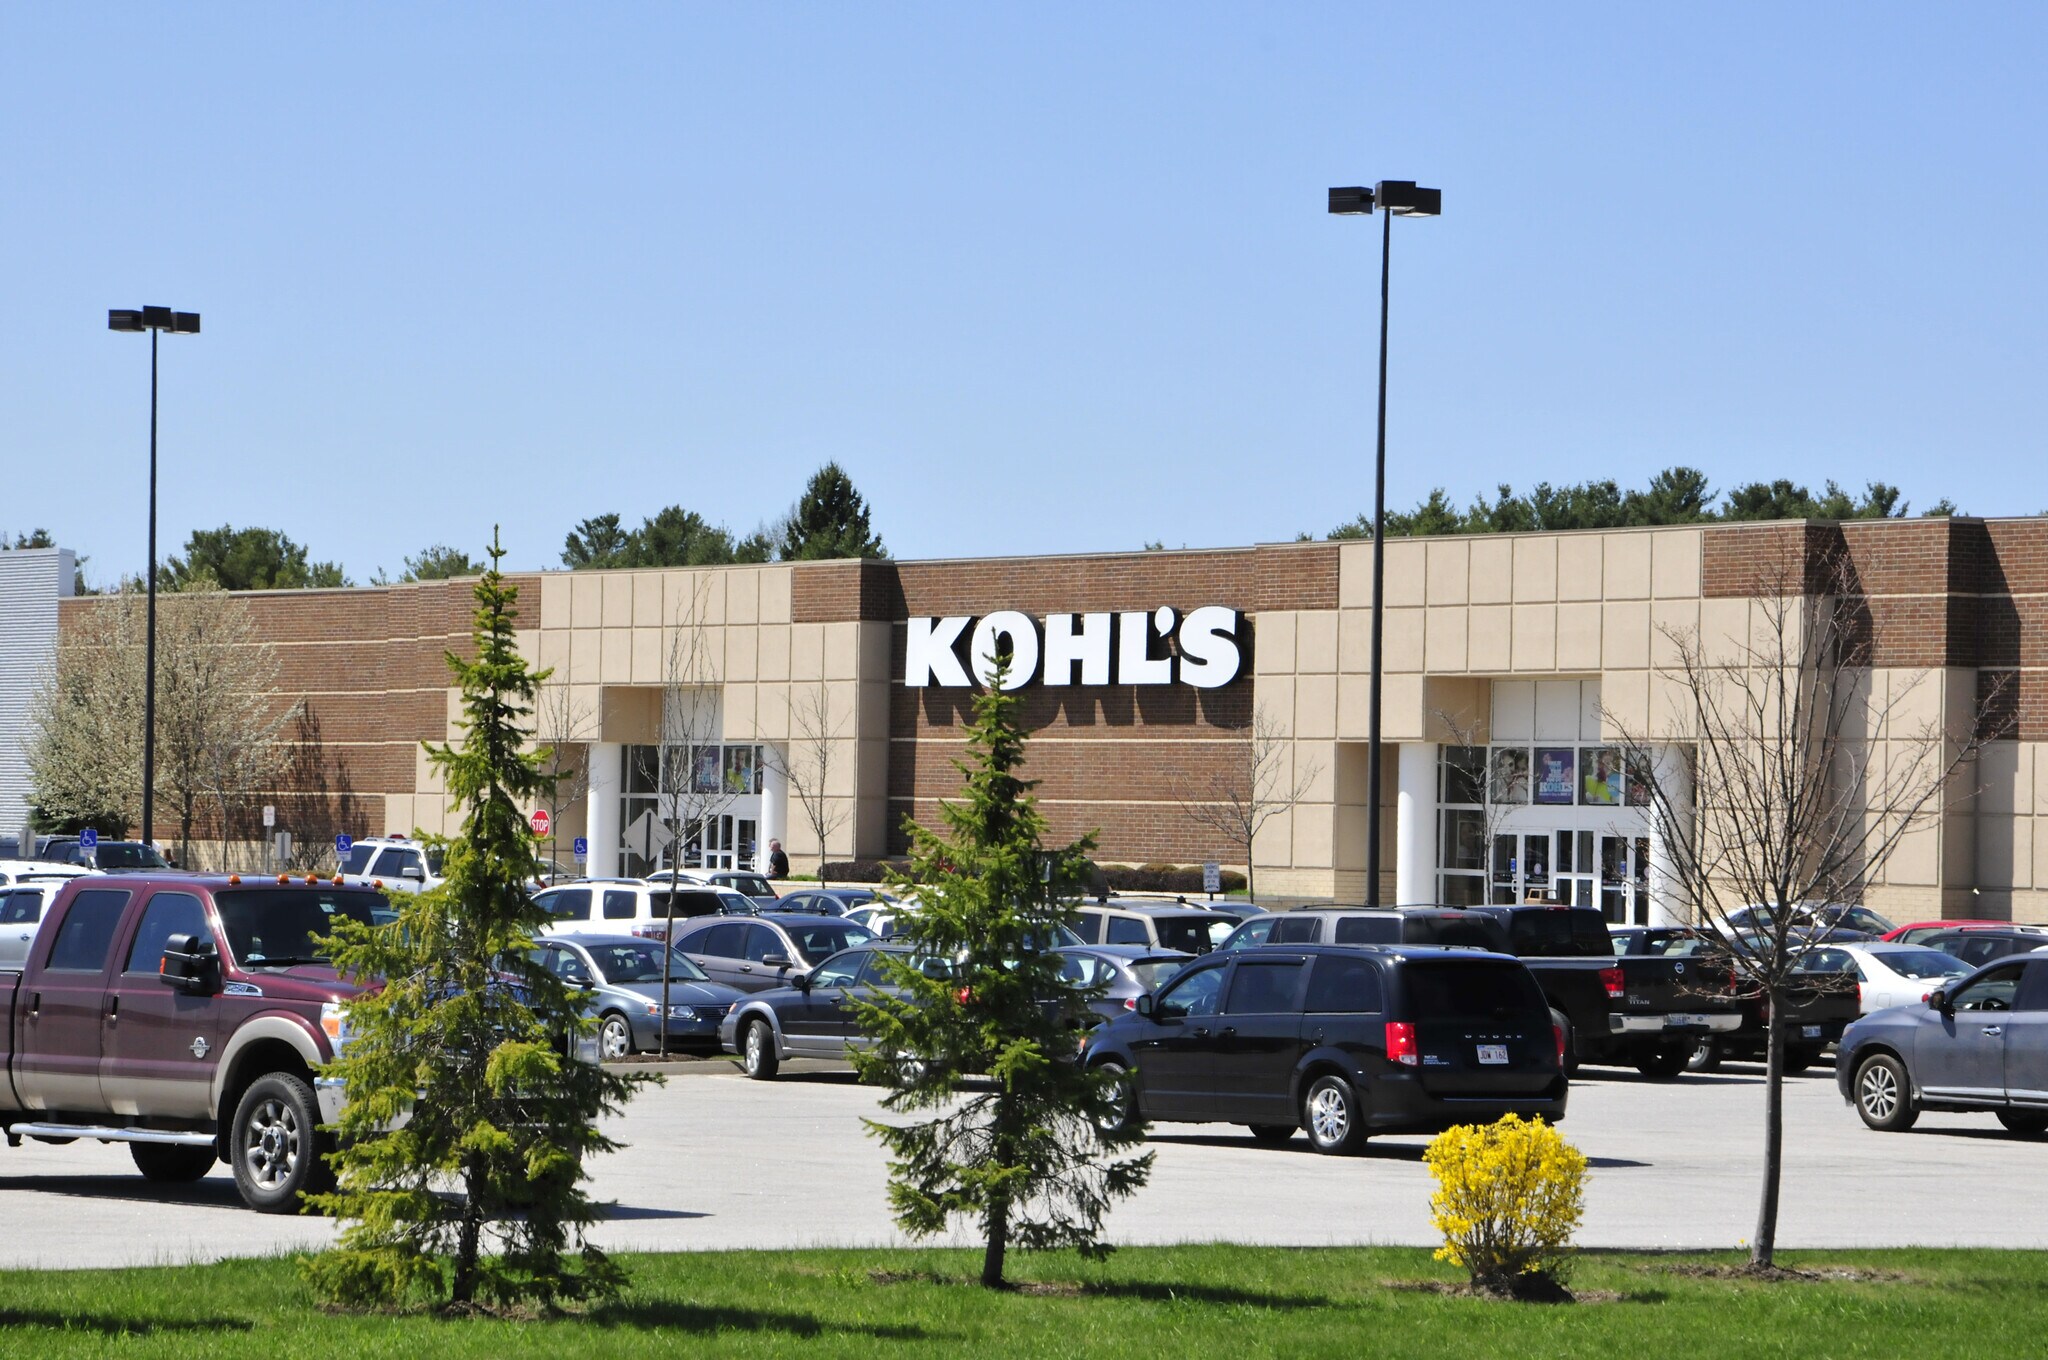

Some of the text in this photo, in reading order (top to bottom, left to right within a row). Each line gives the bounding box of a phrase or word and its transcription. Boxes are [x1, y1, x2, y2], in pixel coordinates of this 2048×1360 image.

[905, 606, 1241, 690] KOHL'S
[531, 819, 549, 831] STOP
[1494, 1050, 1507, 1060] 162
